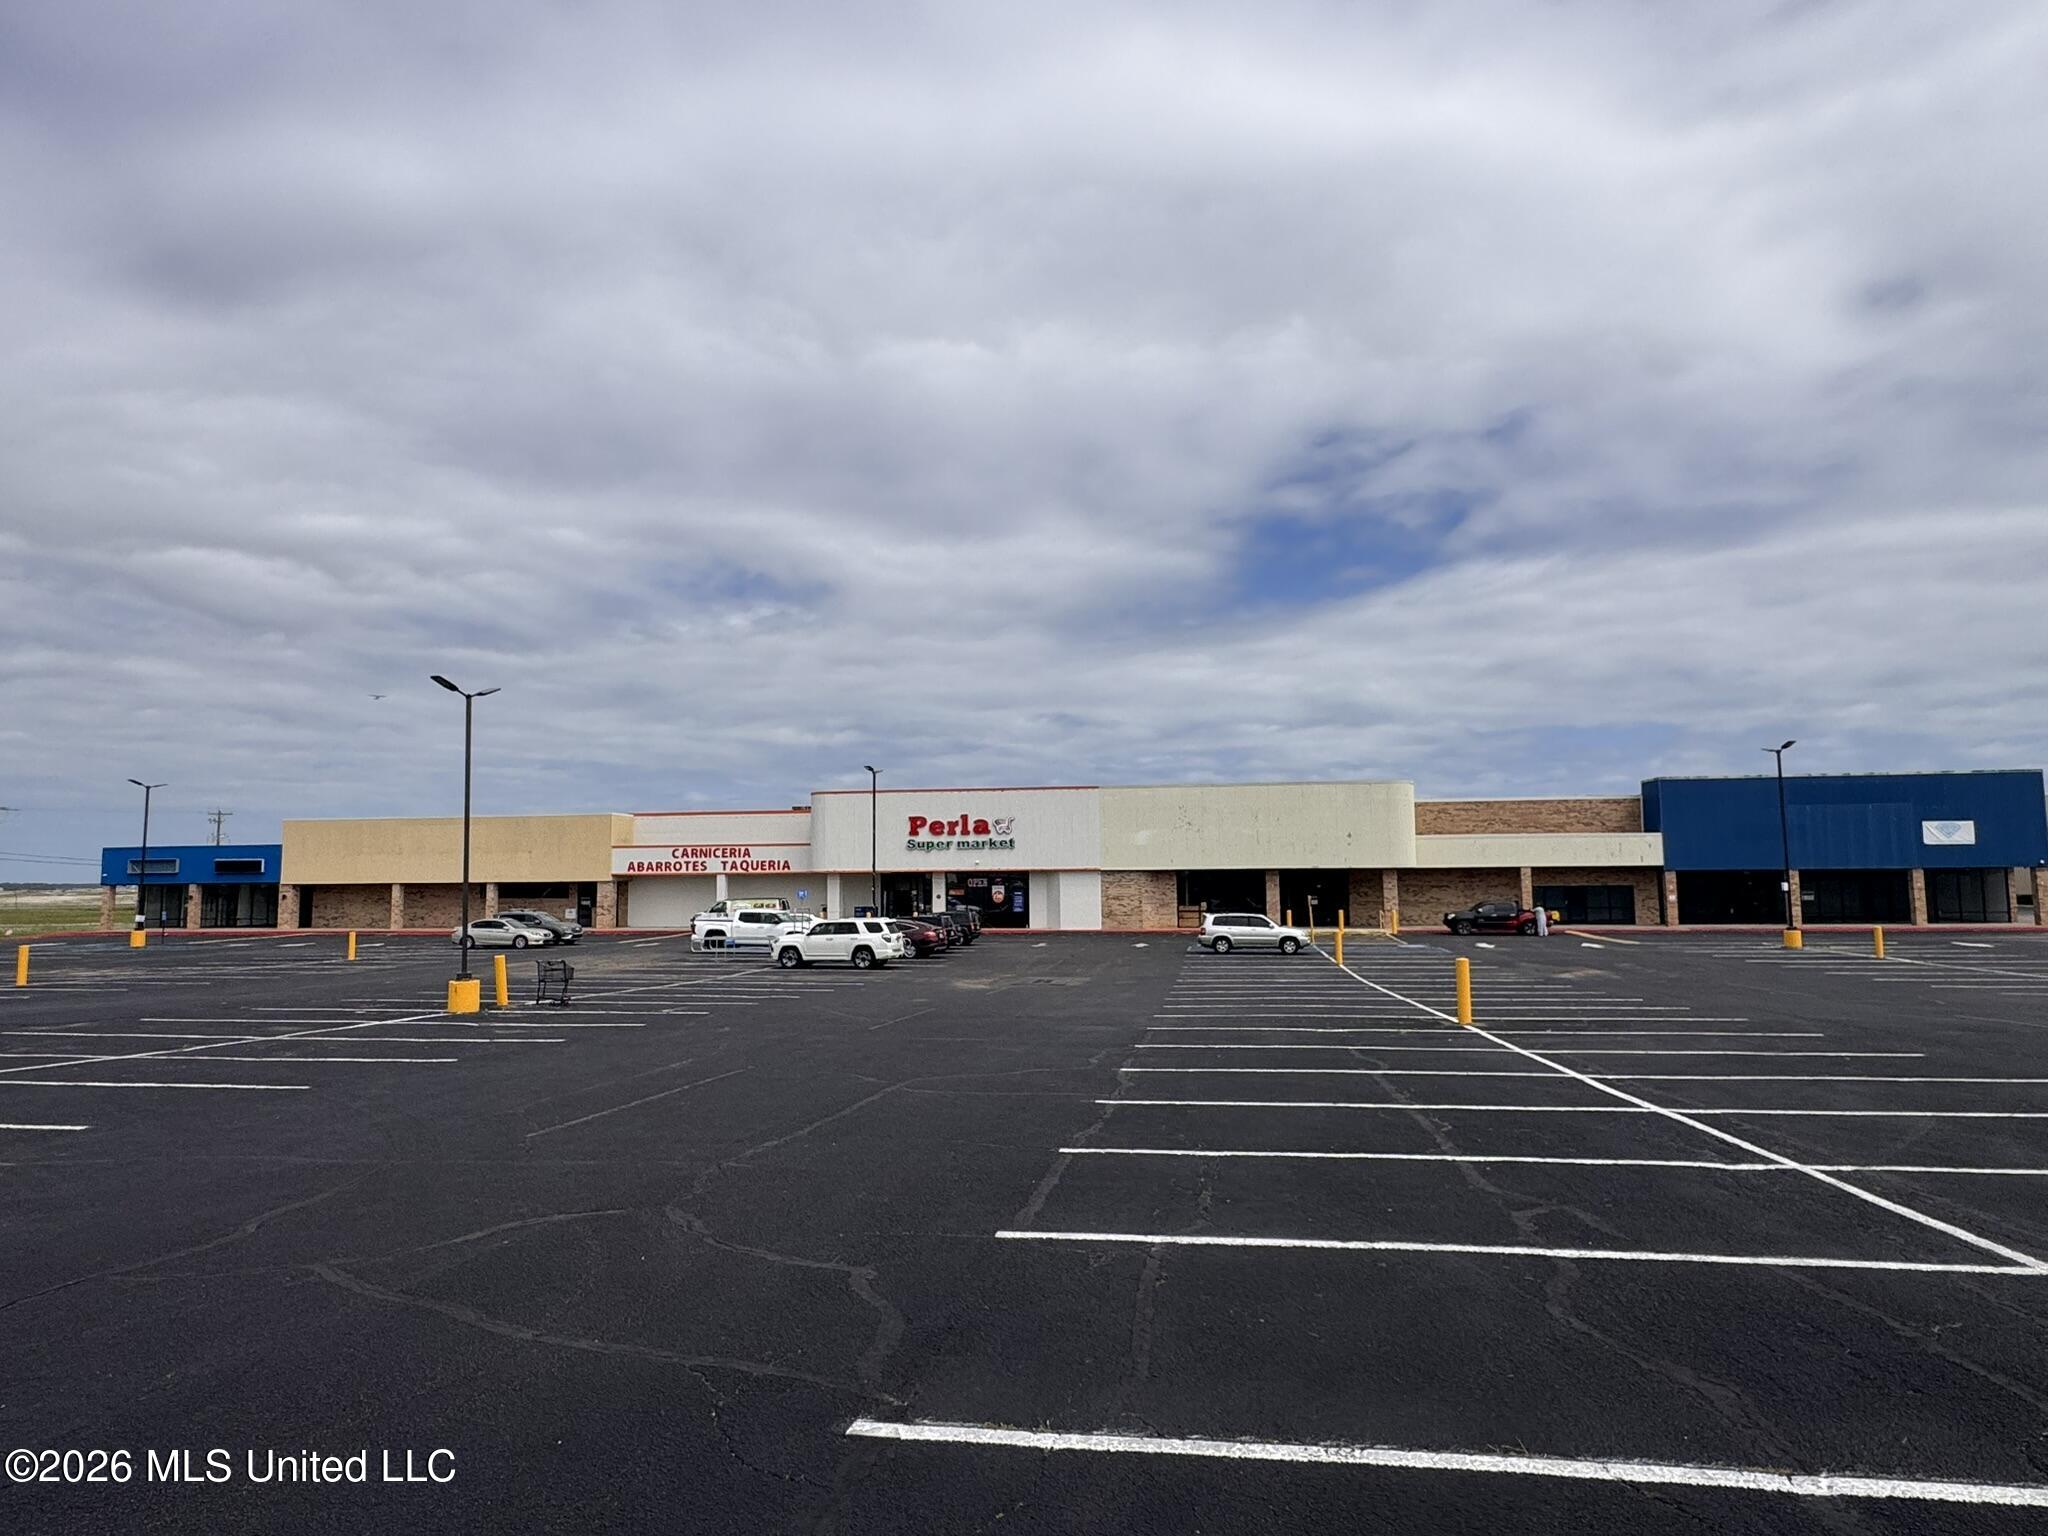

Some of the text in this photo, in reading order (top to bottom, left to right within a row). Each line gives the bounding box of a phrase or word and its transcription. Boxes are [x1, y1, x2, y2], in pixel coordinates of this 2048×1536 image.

[908, 814, 991, 836] Perla
[907, 837, 1016, 851] Super market
[672, 848, 751, 859] CARNICERIA
[627, 860, 791, 872] ABARROTES TAQUERIA
[967, 878, 988, 888] OPEN
